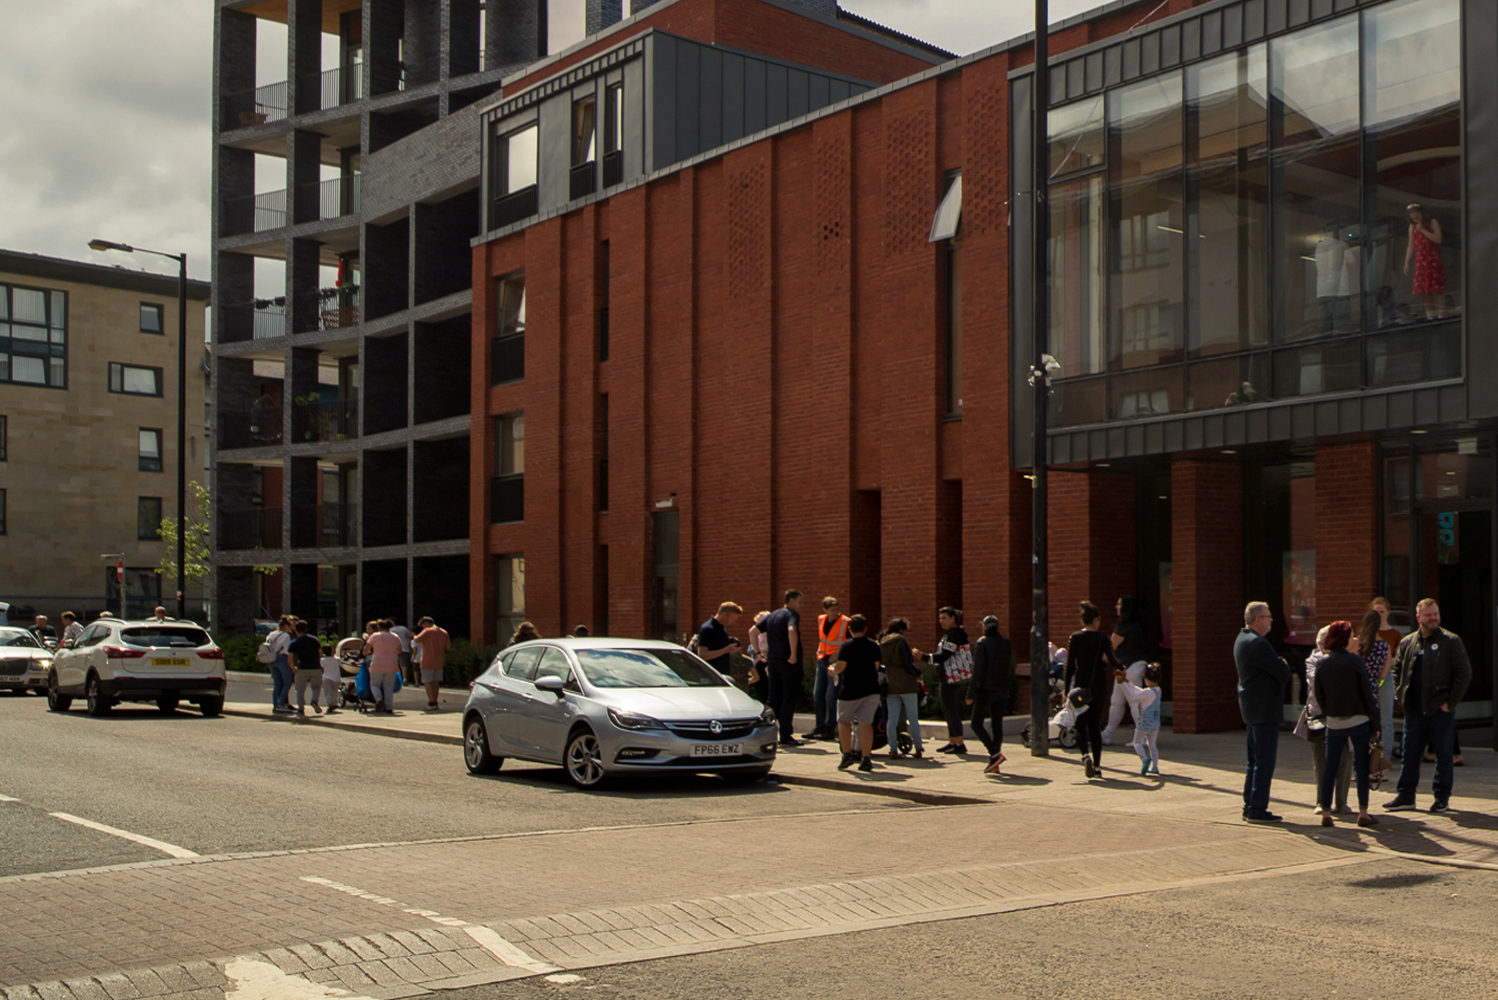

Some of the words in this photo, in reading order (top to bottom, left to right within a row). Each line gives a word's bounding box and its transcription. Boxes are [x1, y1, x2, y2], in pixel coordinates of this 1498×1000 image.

[1291, 574, 1316, 590] PART
[1291, 598, 1316, 606] PIAZZ
[694, 744, 719, 754] FP66
[722, 744, 739, 753] EWZ
